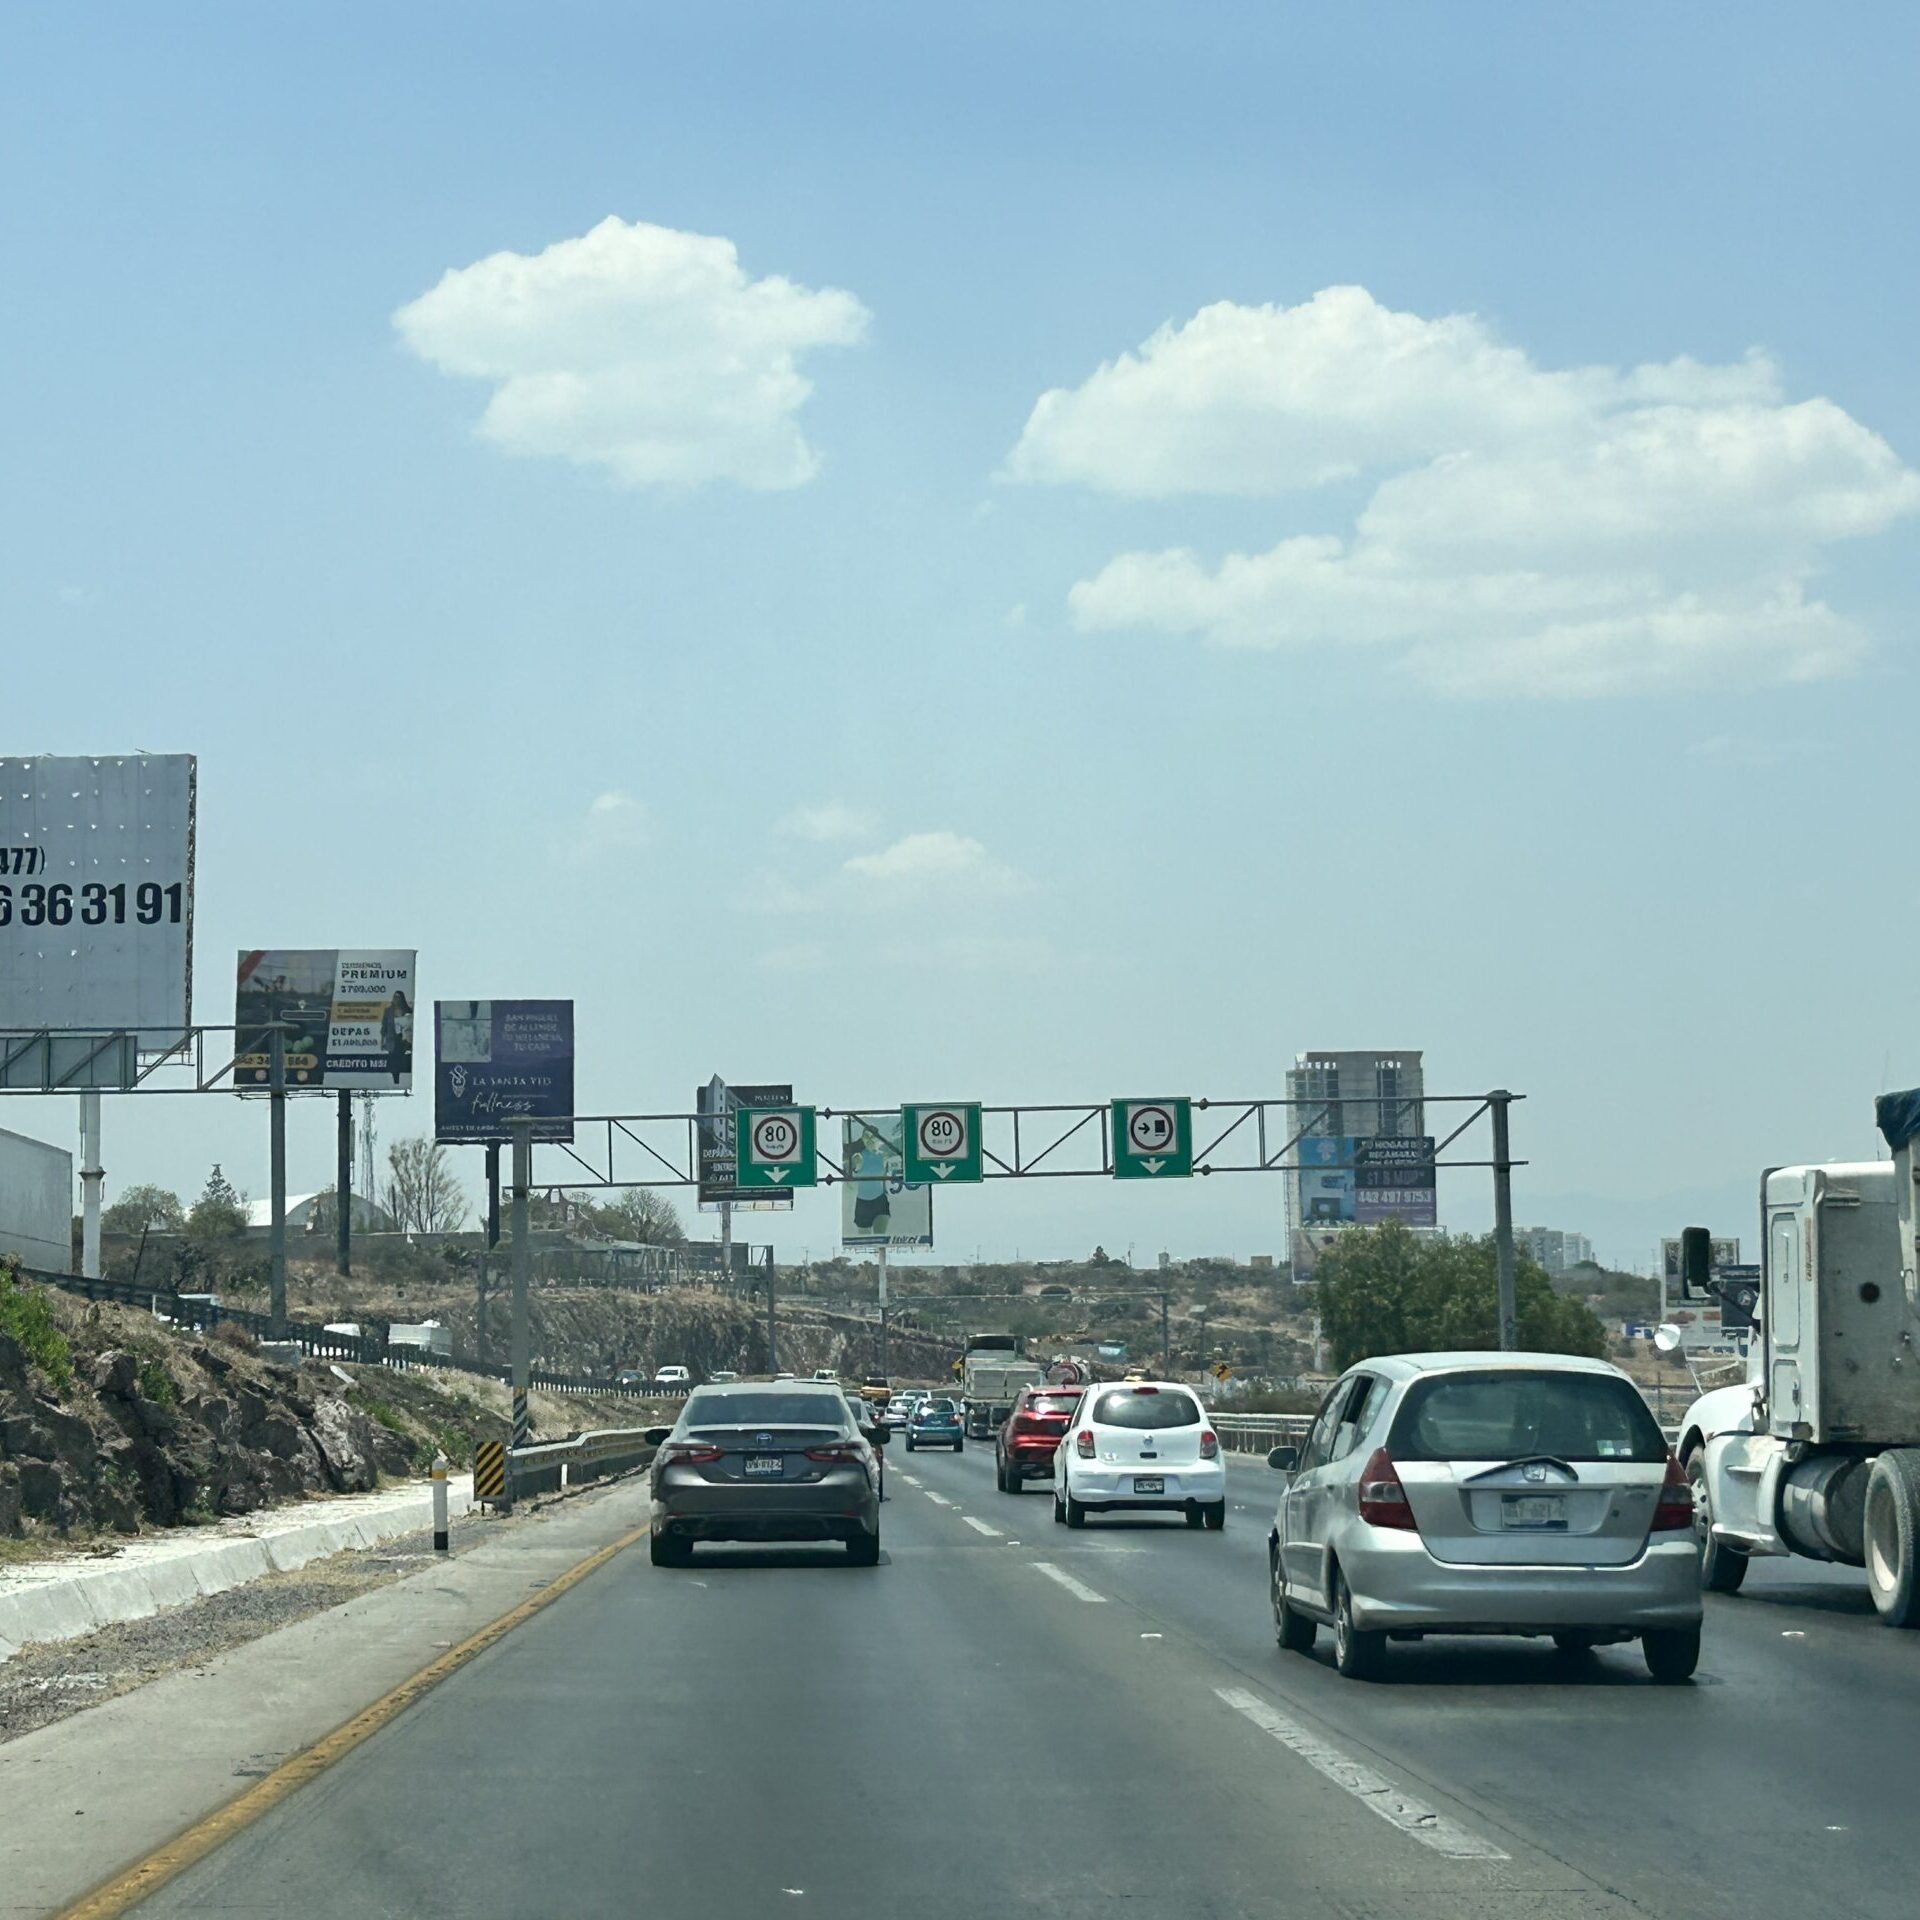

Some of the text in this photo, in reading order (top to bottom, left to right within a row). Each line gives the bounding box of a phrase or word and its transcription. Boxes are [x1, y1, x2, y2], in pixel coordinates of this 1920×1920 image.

[341, 970, 407, 979] PREMIUM
[332, 1028, 370, 1036] DEPAS
[473, 1077, 486, 1085] LA
[931, 1120, 953, 1137] 80
[765, 1125, 786, 1143] 80
